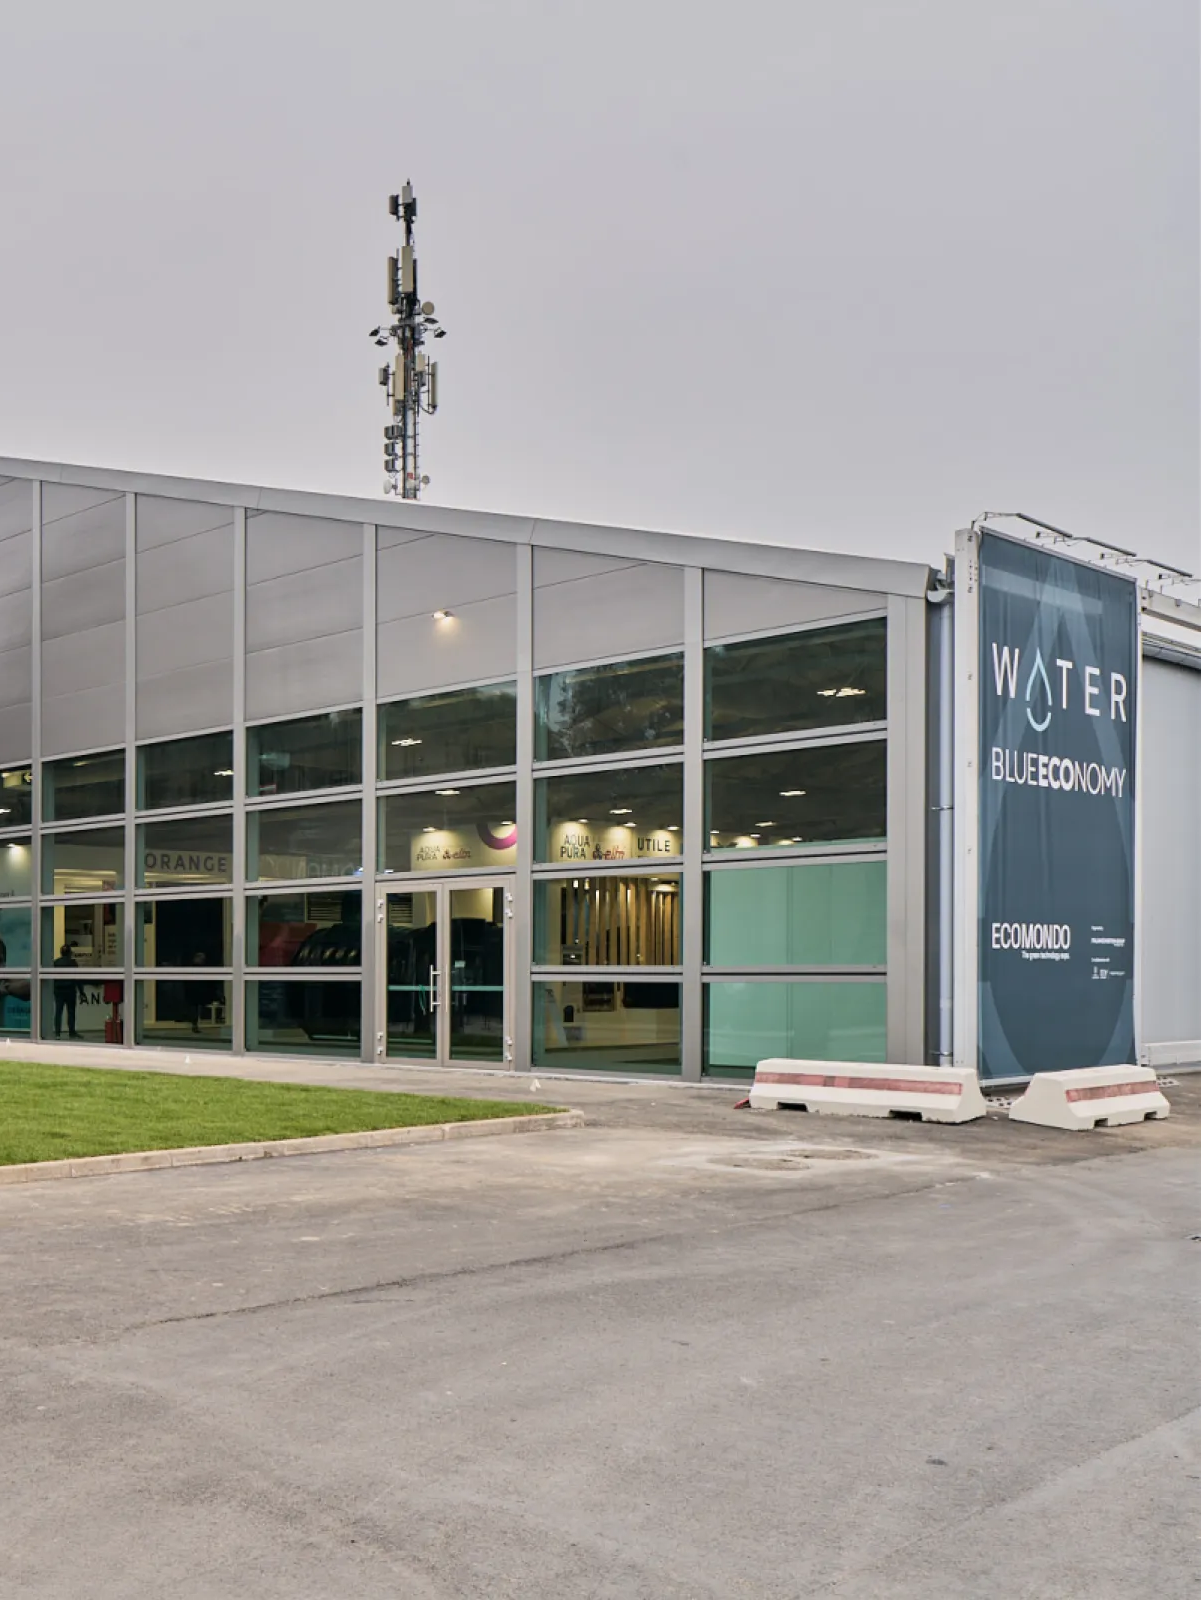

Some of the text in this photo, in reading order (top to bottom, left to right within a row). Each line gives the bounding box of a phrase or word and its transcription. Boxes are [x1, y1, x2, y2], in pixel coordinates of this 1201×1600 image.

[991, 747, 1127, 798] BLUEECONOMY
[637, 837, 671, 853] UTILE
[144, 852, 228, 873] ORANGE
[991, 922, 1071, 949] ECOMONDO
